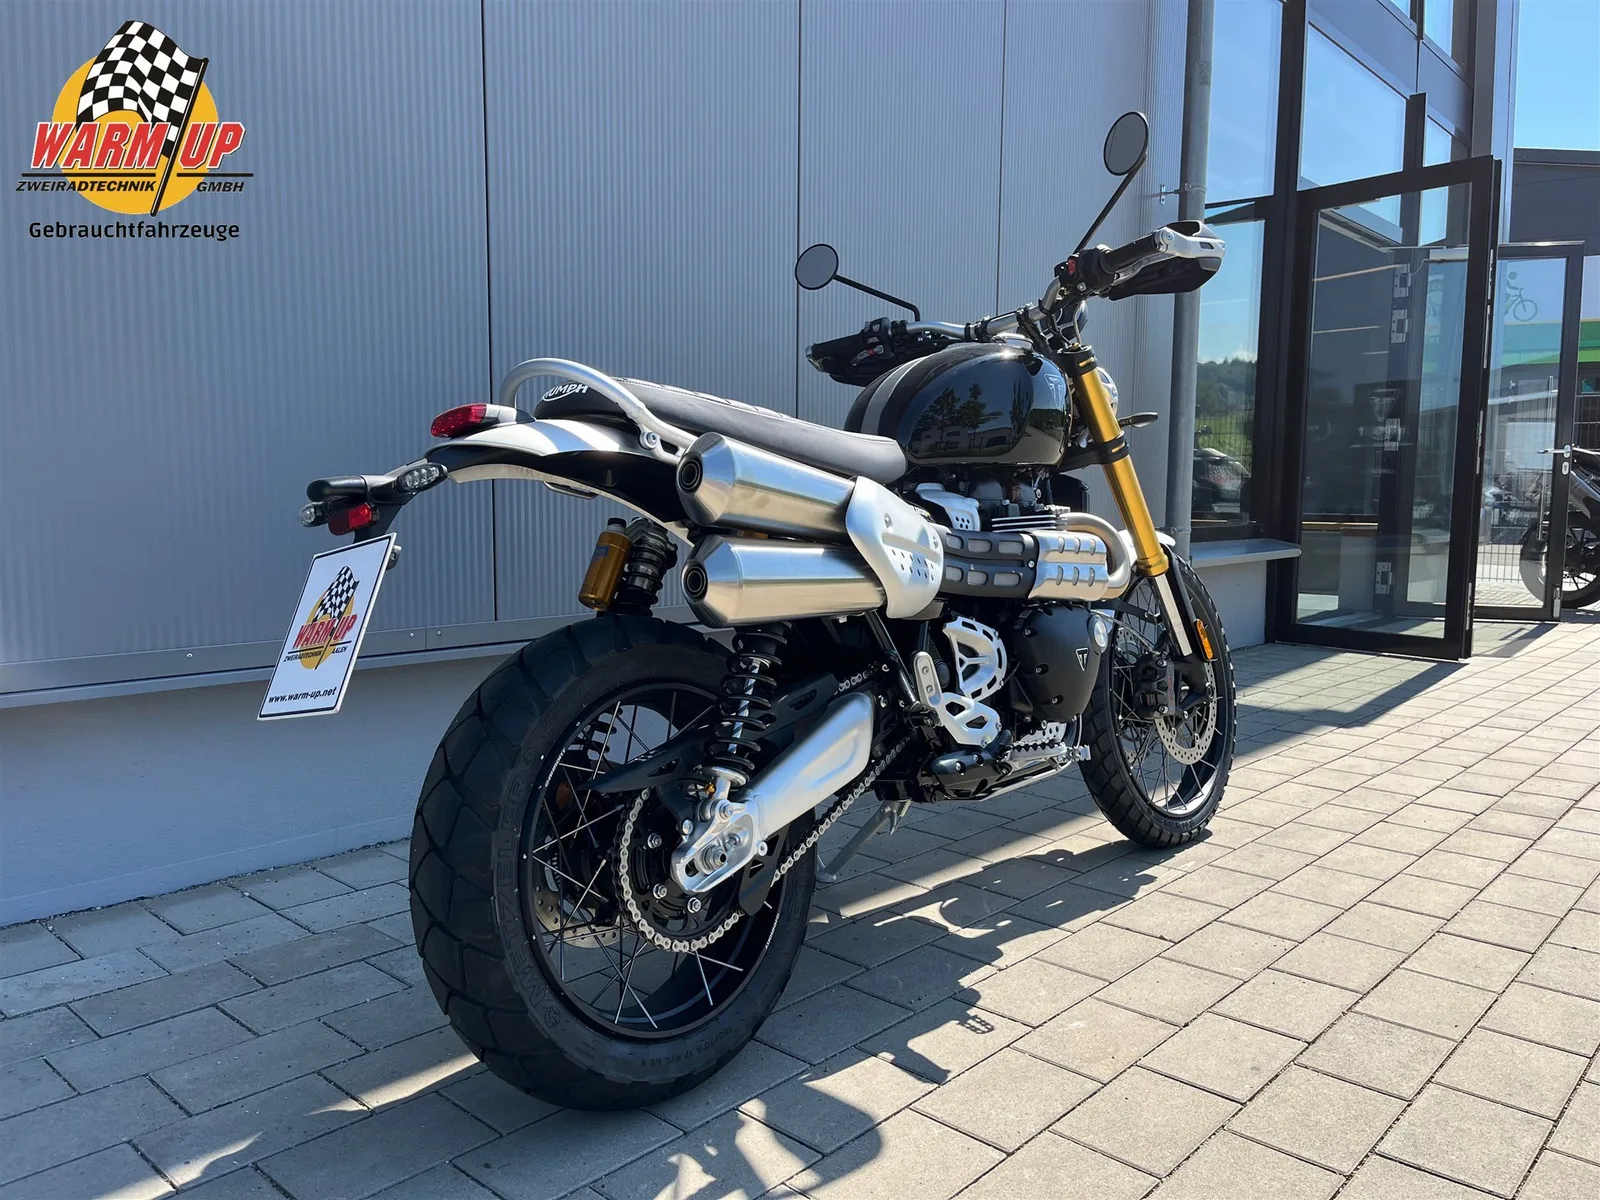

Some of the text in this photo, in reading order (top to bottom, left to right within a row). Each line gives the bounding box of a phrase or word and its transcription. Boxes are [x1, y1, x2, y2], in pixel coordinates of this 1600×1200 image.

[293, 614, 357, 648] WARM UP
[268, 686, 337, 703] www.warm-up.net
